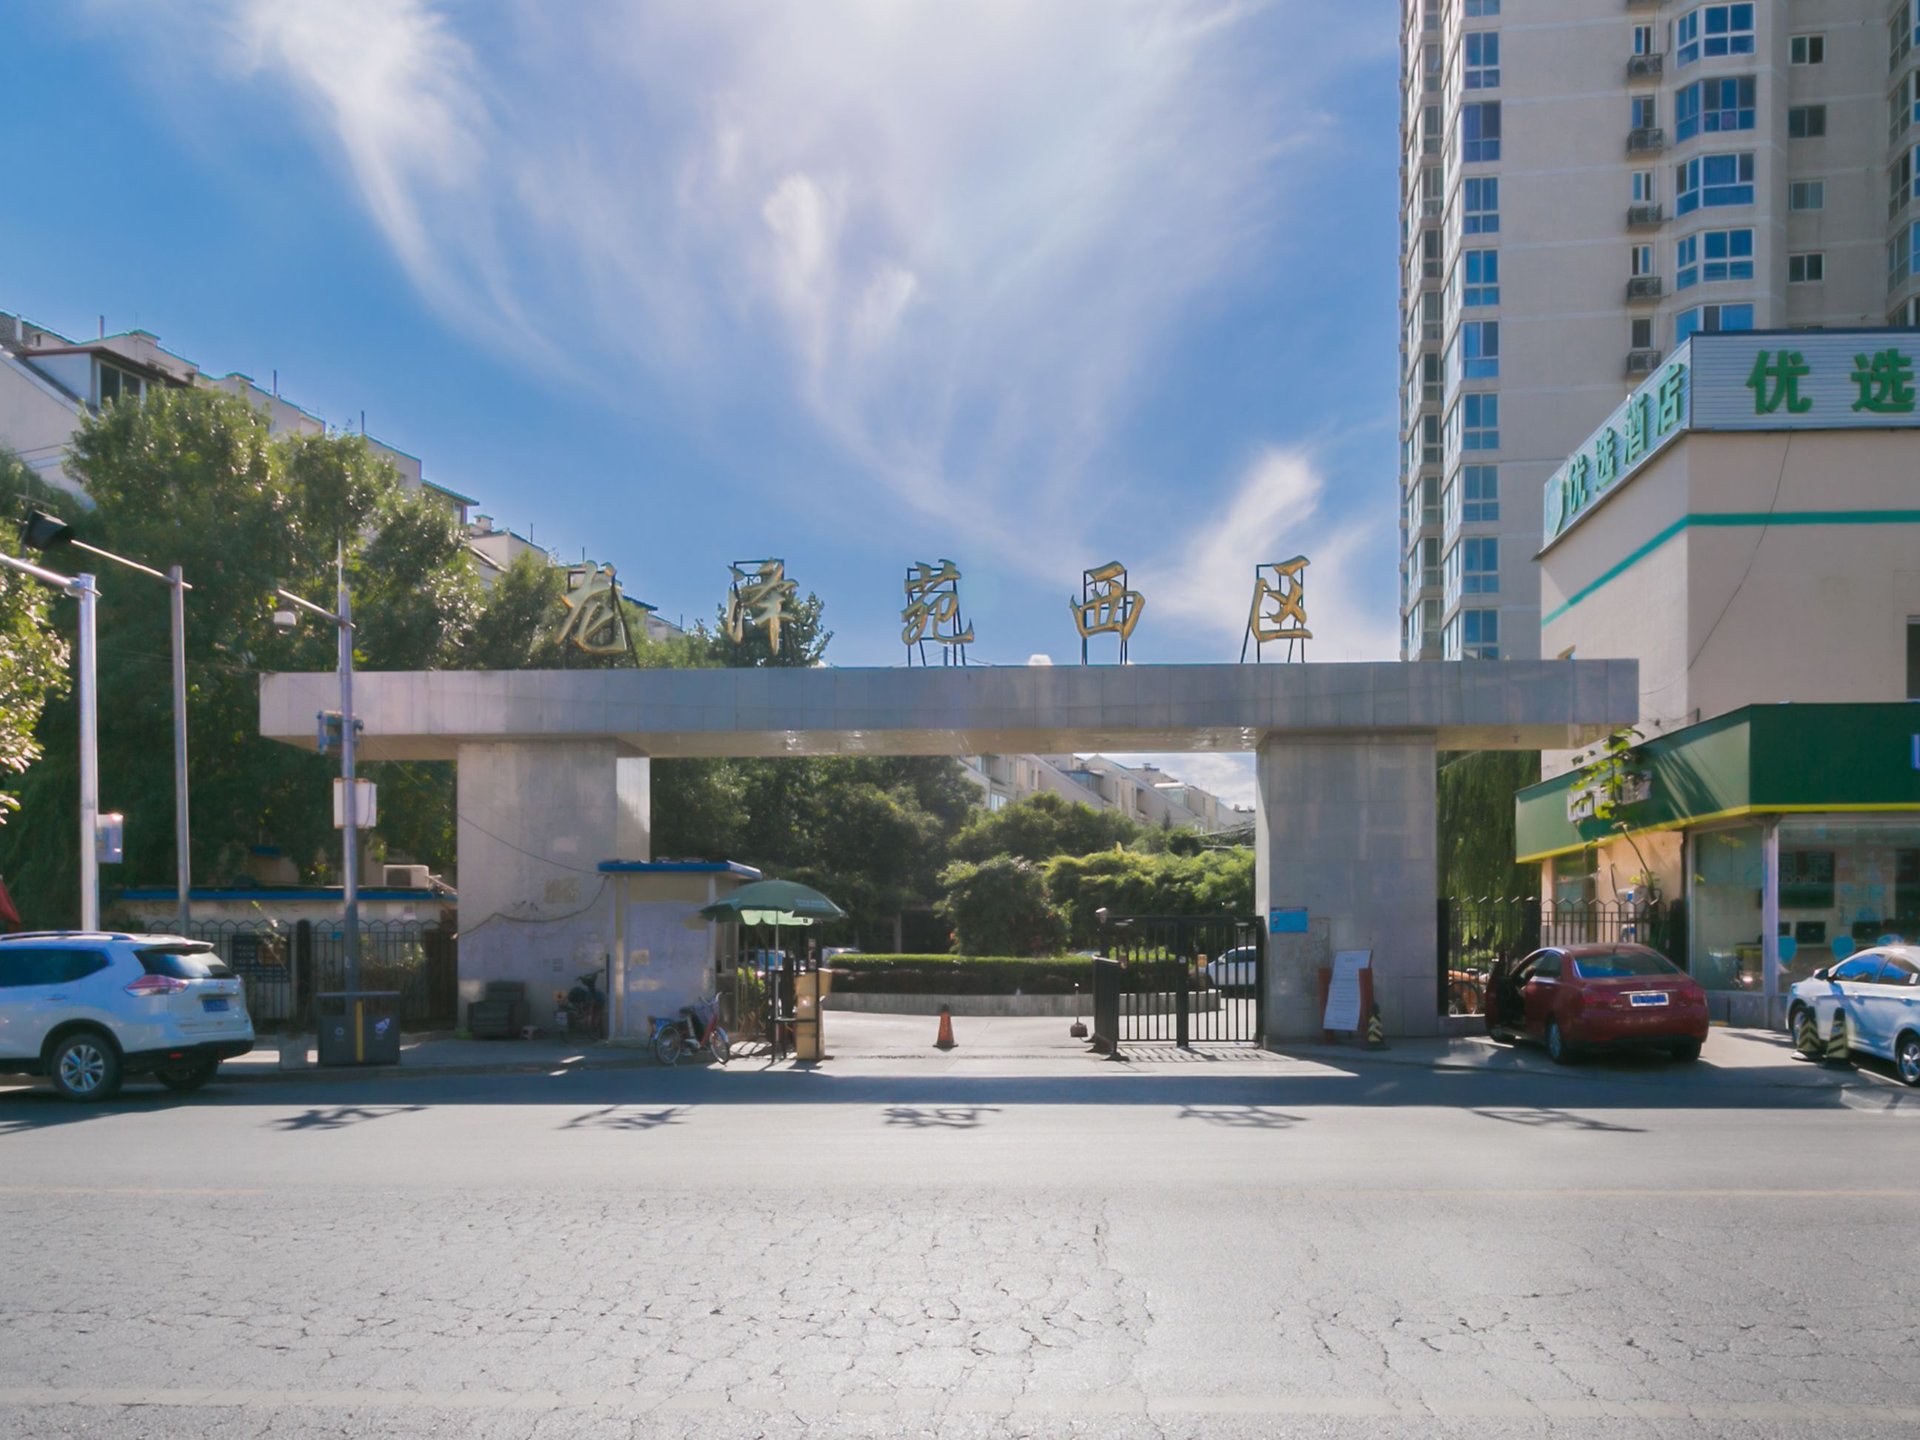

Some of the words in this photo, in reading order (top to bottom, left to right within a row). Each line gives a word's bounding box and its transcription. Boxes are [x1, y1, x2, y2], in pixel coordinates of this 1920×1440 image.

[1745, 348, 1916, 415] 优选
[1568, 362, 1685, 515] 优选酒店
[553, 555, 1313, 658] 龙泽苑西区
